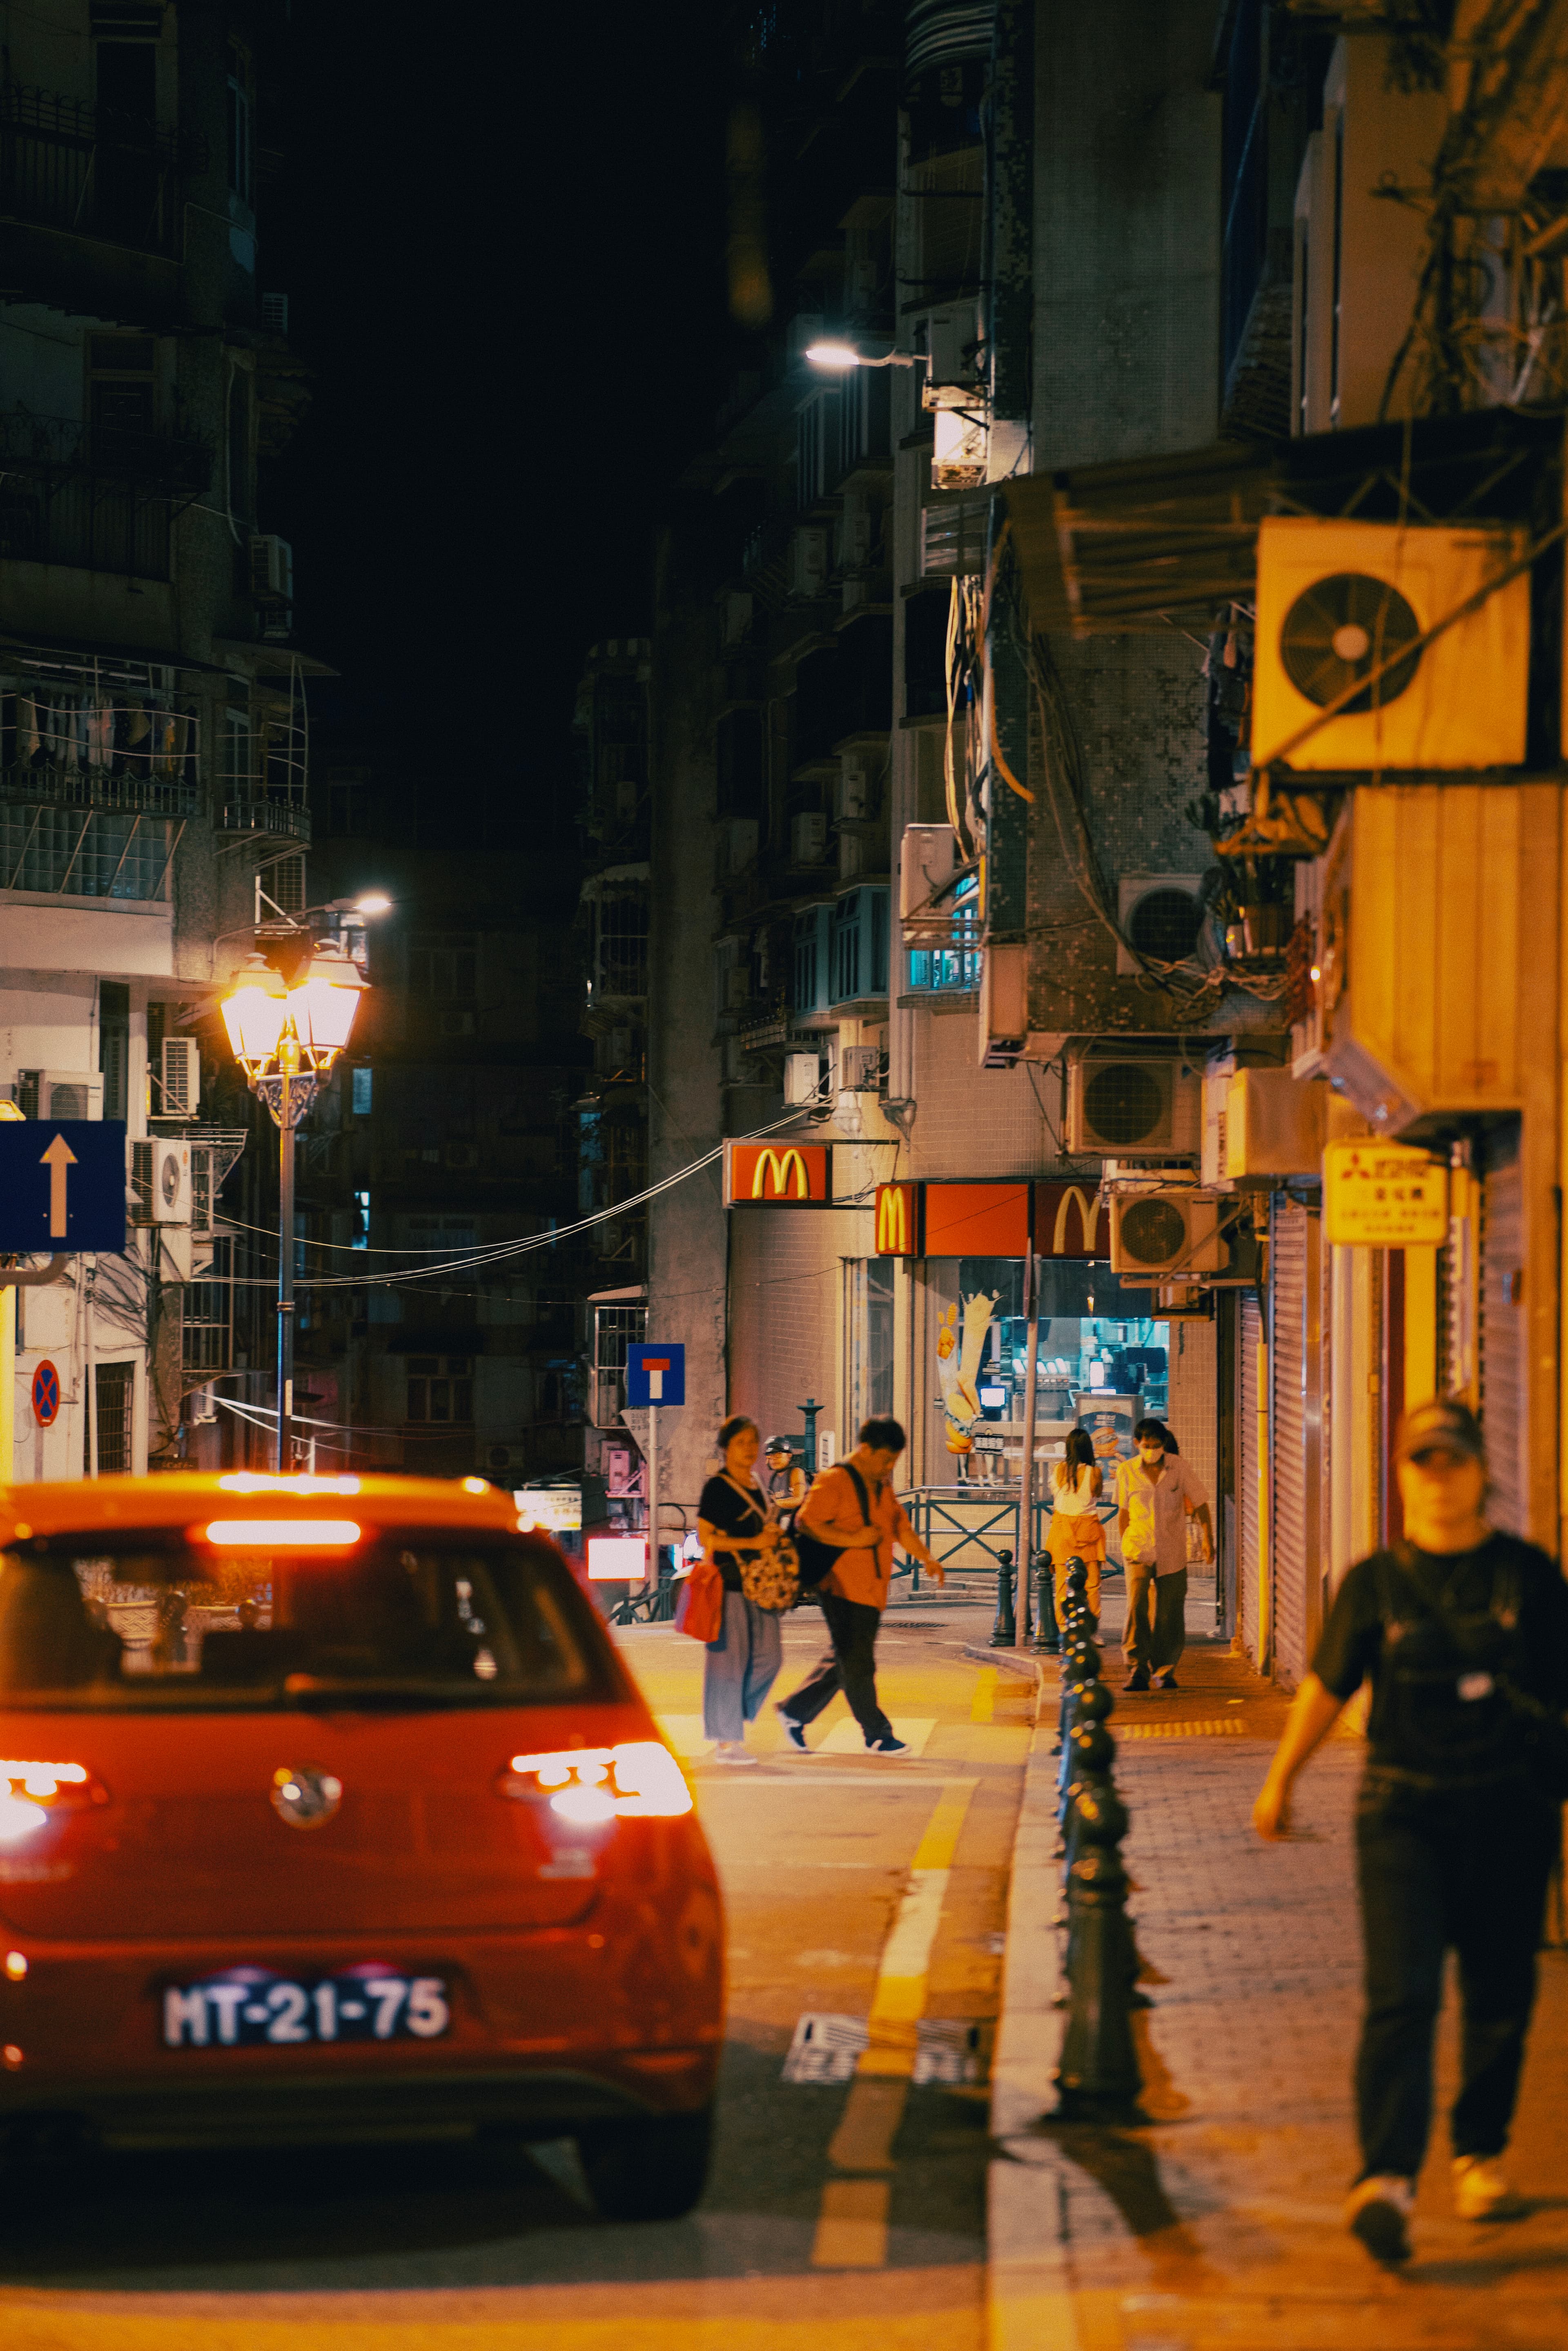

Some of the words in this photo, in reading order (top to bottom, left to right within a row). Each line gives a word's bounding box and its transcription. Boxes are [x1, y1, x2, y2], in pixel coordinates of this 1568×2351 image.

[752, 1148, 810, 1199] M
[878, 1187, 906, 1252] M
[164, 1978, 450, 2046] MT-21-75
